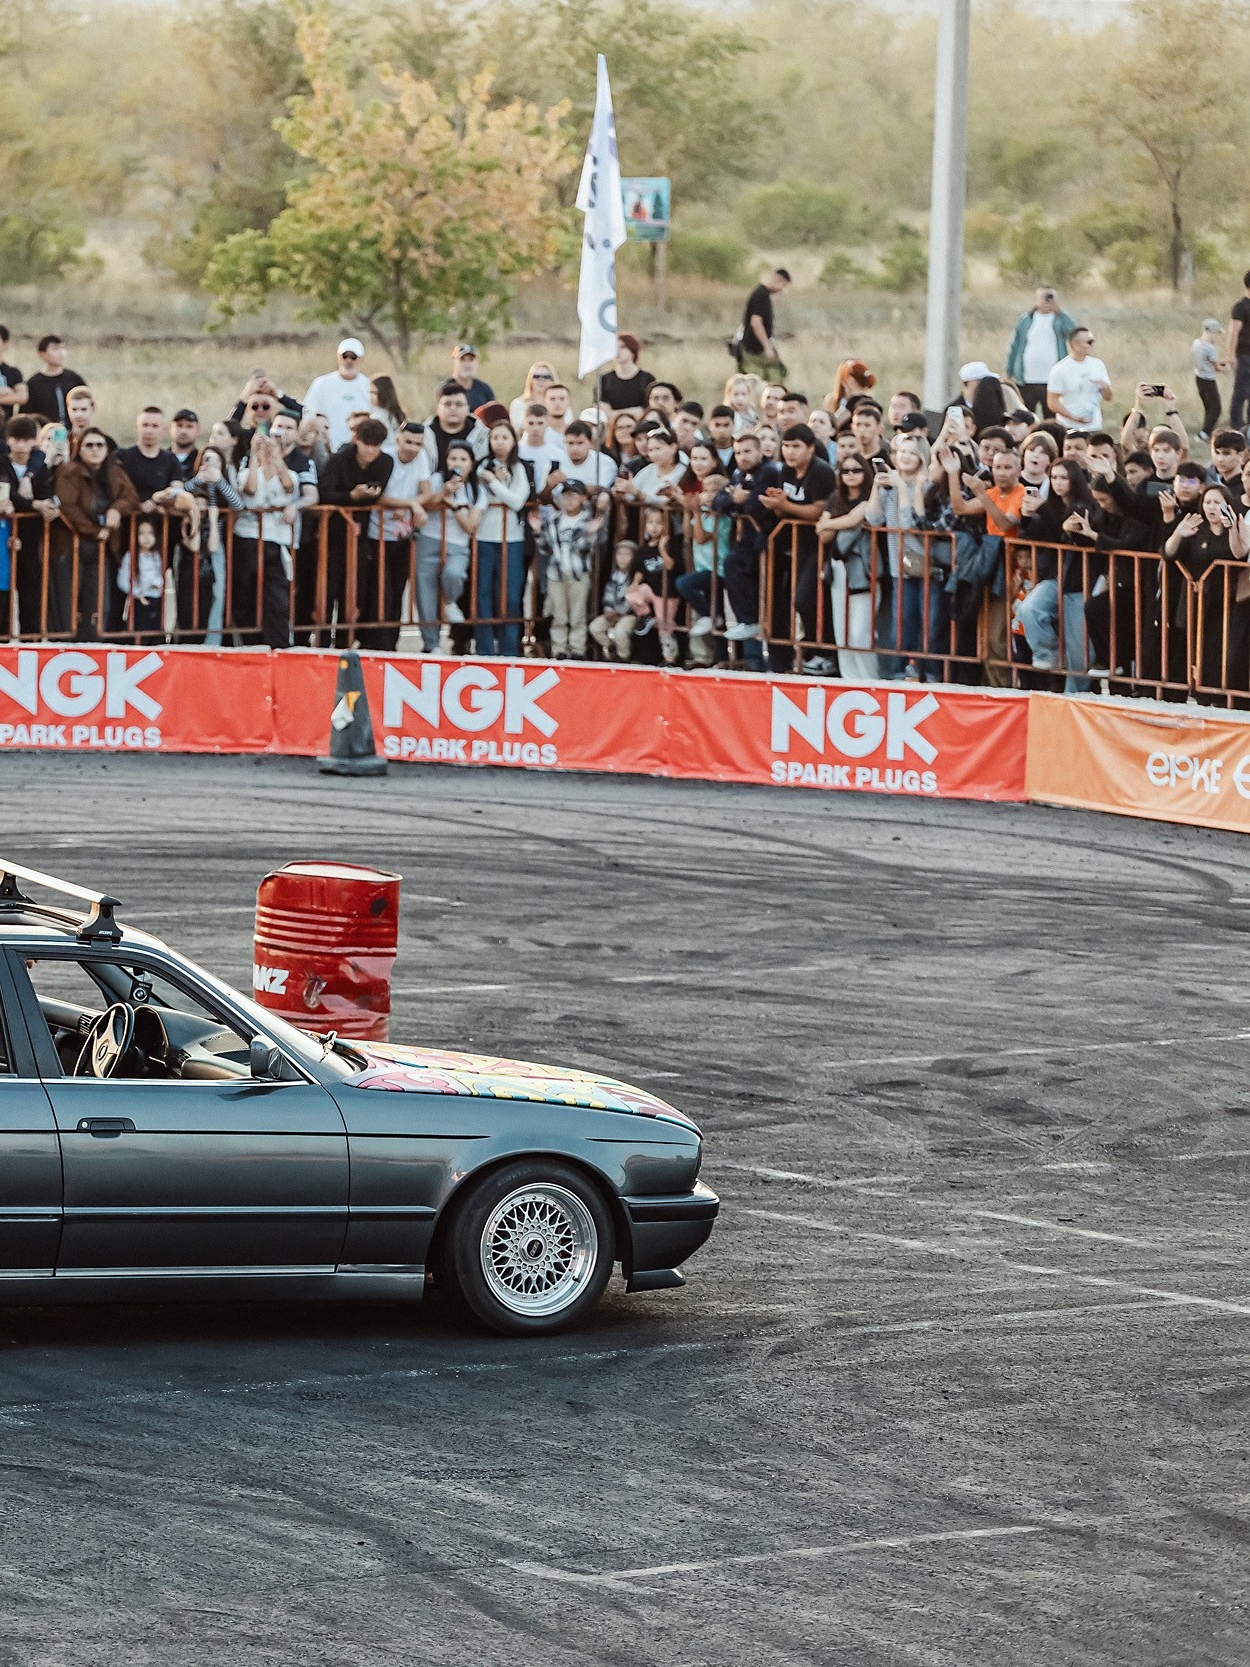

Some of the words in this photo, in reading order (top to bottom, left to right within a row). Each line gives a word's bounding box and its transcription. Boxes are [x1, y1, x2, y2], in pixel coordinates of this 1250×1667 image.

[383, 661, 561, 738] NGK
[72, 725, 163, 748] PLUGS
[770, 685, 941, 766] NGK
[383, 735, 468, 761] SPARK
[471, 739, 559, 765] PLUGS
[770, 760, 851, 786] SPARK
[855, 765, 938, 792] PLUGS
